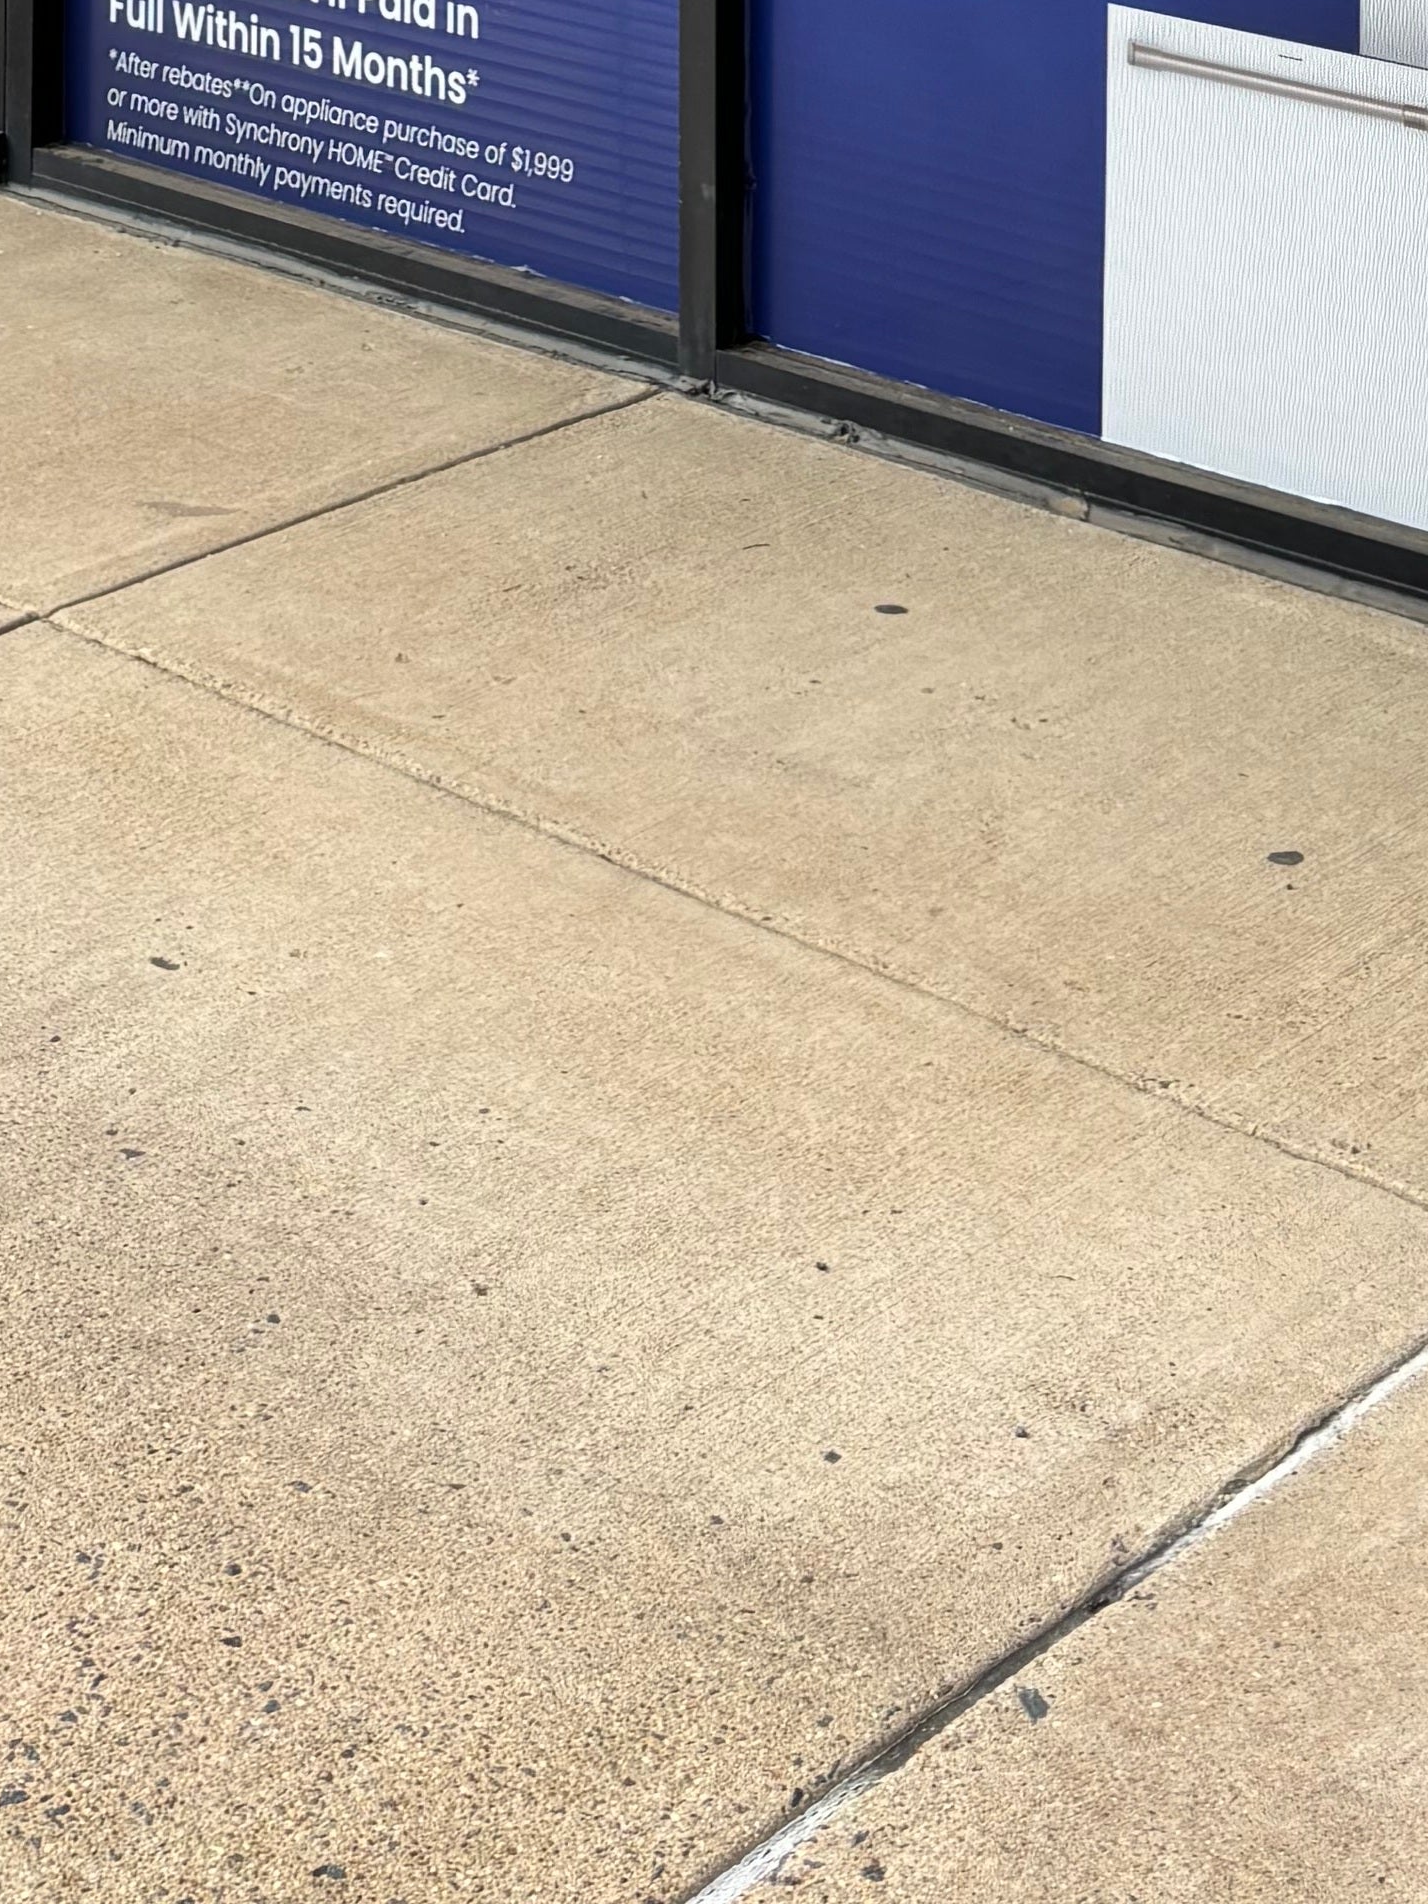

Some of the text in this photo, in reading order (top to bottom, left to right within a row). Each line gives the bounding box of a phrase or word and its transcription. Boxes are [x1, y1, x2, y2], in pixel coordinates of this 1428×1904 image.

[172, 0, 281, 62] Within
[289, 24, 323, 70] 15
[107, 88, 126, 107] or
[130, 92, 179, 121] more
[182, 104, 221, 132] with
[225, 112, 324, 165] Synchrony
[394, 156, 457, 193] Credit
[461, 173, 517, 209] Card.
[107, 119, 466, 234] Minimum monthly payments required.
[281, 94, 379, 134] appliance
[383, 119, 480, 159] purchase
[484, 142, 508, 166] of
[511, 145, 574, 183] $1,999
